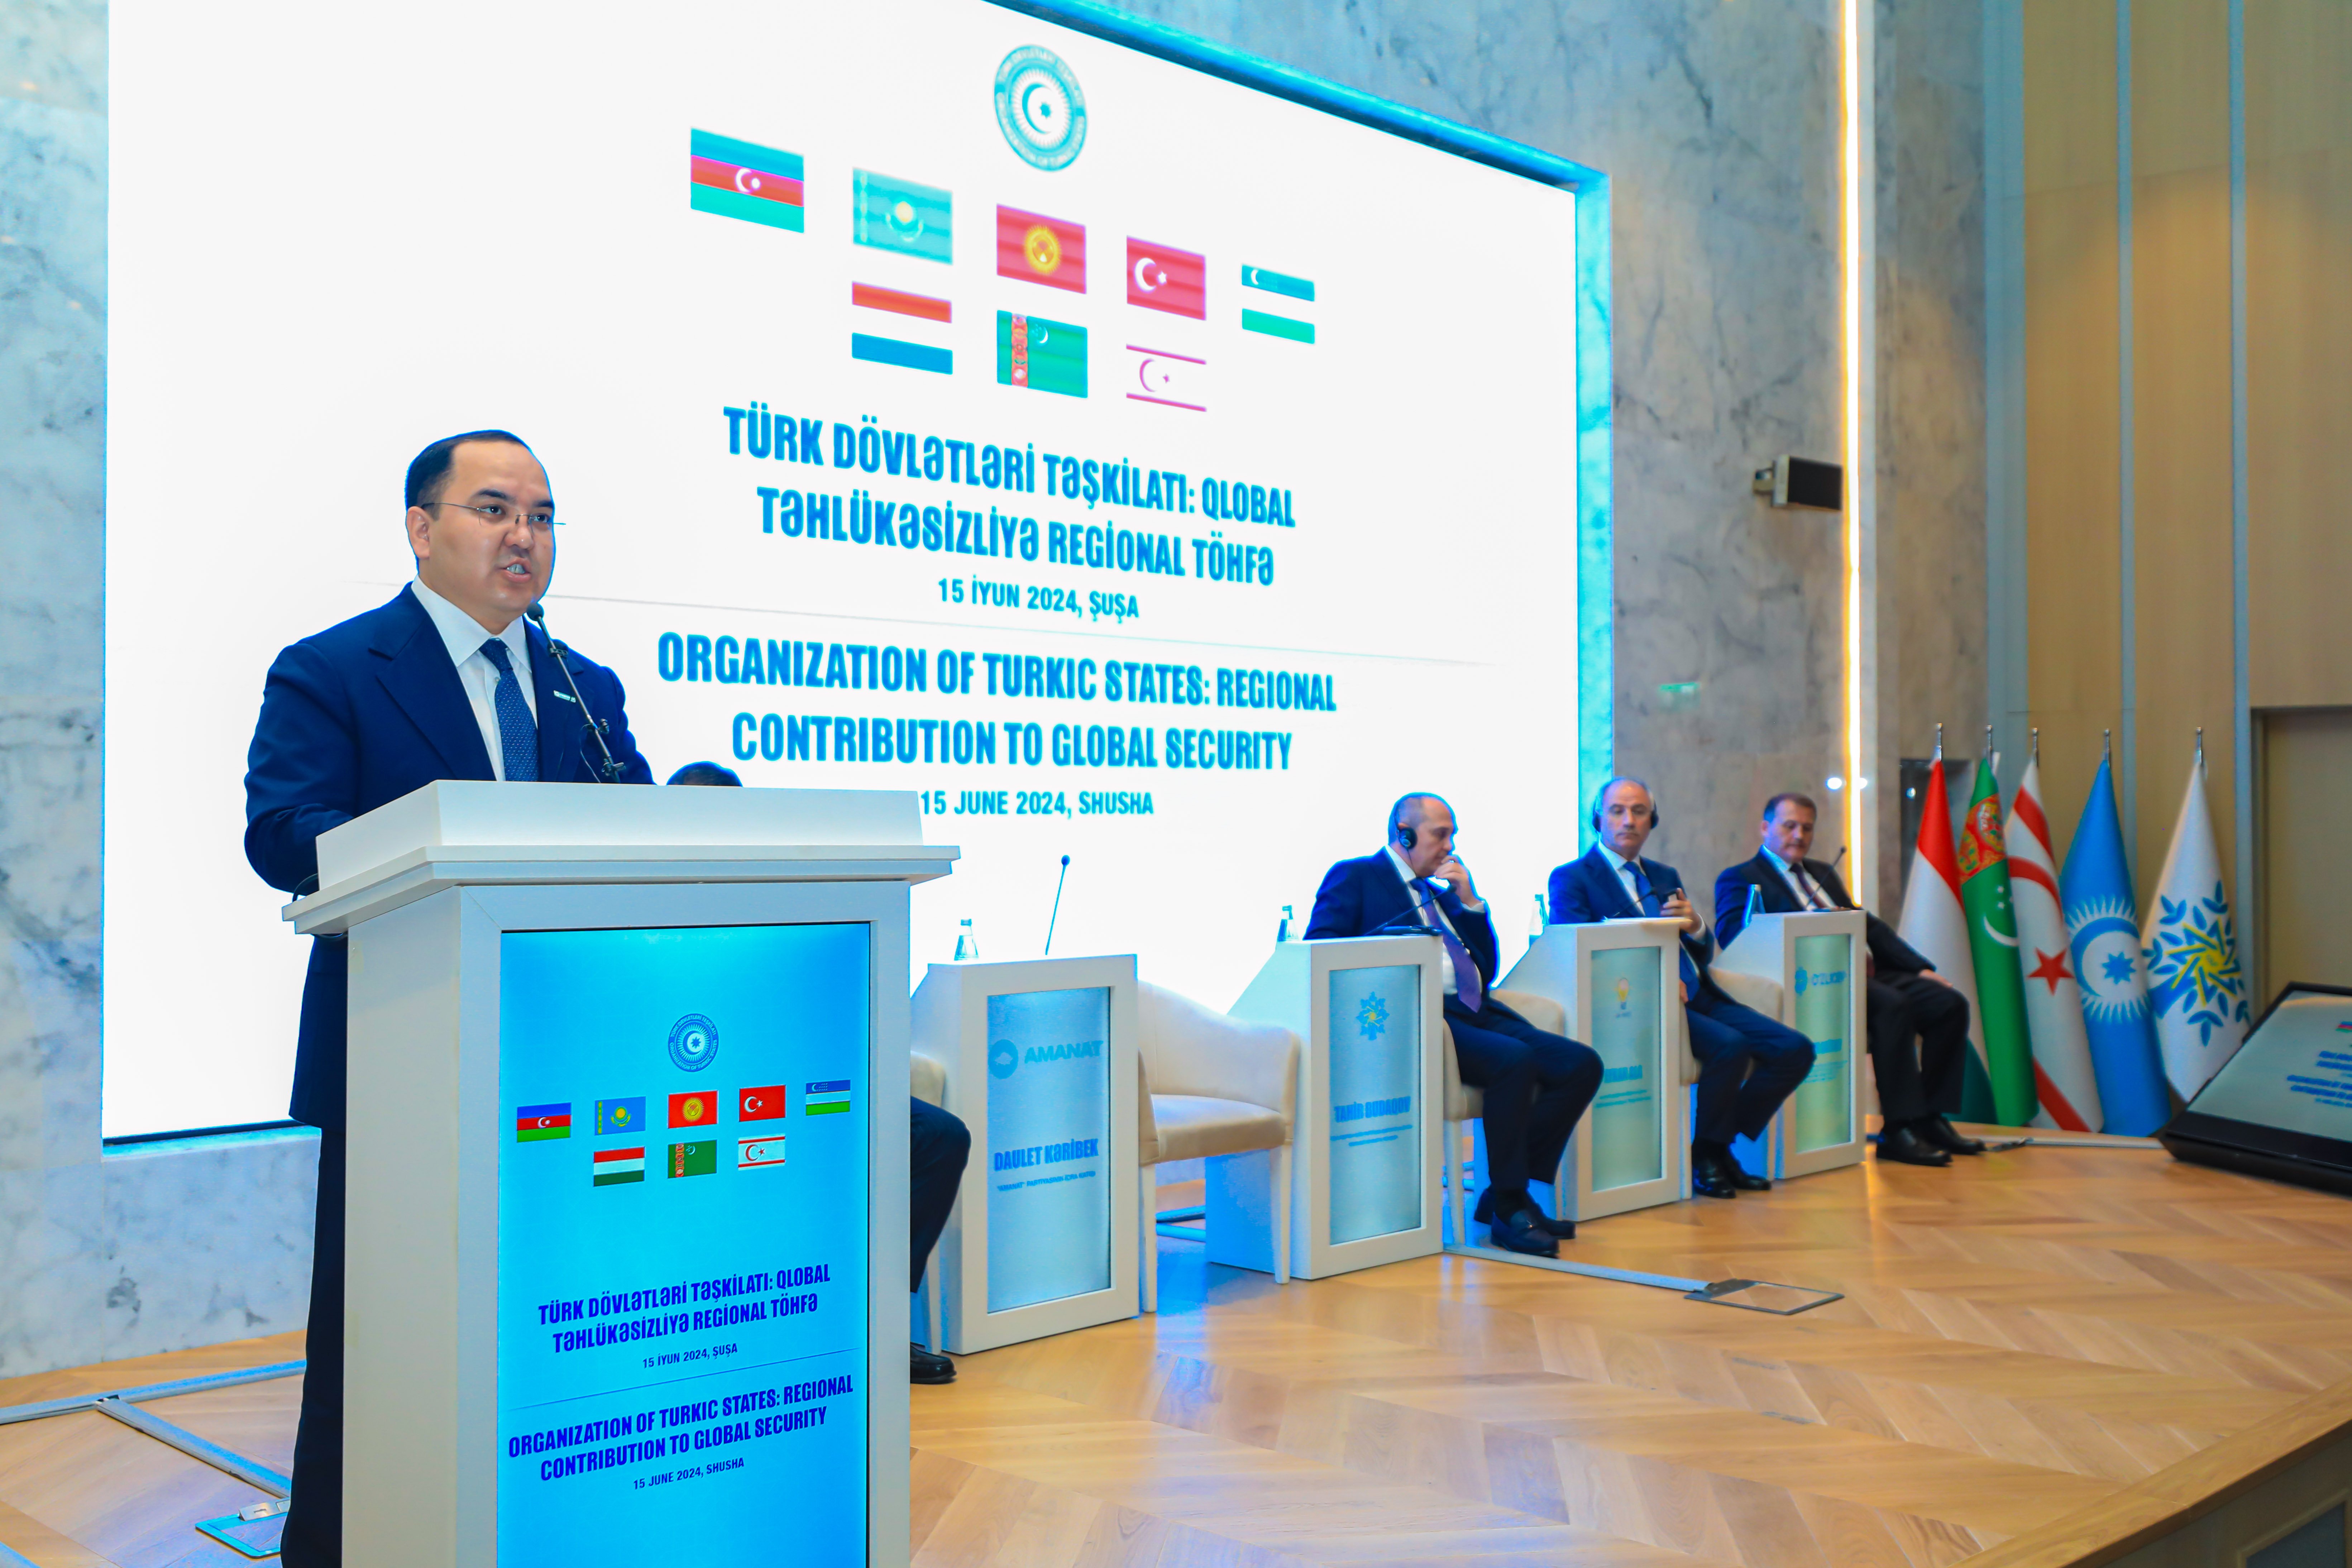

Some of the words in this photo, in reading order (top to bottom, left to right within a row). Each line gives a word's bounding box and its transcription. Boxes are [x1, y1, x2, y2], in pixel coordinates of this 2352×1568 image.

[723, 401, 824, 466] TÜRK
[833, 415, 1034, 494] DÖVLƏTLƏRİ
[1043, 454, 1195, 513] TƏŞKİLATI:
[1202, 477, 1296, 527] QLOBAL
[757, 485, 1039, 561] TƏHLÜKƏSİZLİYƏ
[1048, 520, 1185, 576] REGİONAL
[1192, 531, 1273, 586] TÖHFƏ
[938, 578, 964, 603] 15
[972, 574, 1019, 608] İYUN
[1027, 586, 1082, 618] 2024,
[1089, 591, 1139, 624] ŞUŞA
[658, 632, 927, 692] ORGANIZATION
[937, 649, 975, 694] OF
[983, 653, 1096, 701] TURKIC
[1105, 660, 1210, 706] STATES:
[1217, 668, 1337, 711] REGIONAL
[732, 712, 995, 765] CONTRIBUTION
[1004, 722, 1042, 766] TO
[1052, 723, 1158, 768] GLOBAL
[1166, 728, 1292, 770] SECURITY
[921, 790, 946, 814] 15
[954, 791, 1008, 814] JUNE
[1016, 791, 1071, 819] 2024,
[1079, 791, 1154, 814] SHUSHA
[1024, 1040, 1104, 1063] AMANAT
[994, 1147, 1043, 1171] DAULET
[1044, 1138, 1099, 1164] KƏRİBEK
[539, 1300, 584, 1325] TÜRK
[589, 1280, 688, 1315] DÖVLƏTLƏRİ
[691, 1273, 773, 1302] TƏŞKİLATI:
[777, 1264, 830, 1289] QLOBAL
[553, 1316, 689, 1353] TƏHLÜKƏSİZLİYƏ
[694, 1301, 767, 1330] REGİONAL
[771, 1293, 817, 1318] TÖHFƏ
[643, 1358, 654, 1368] 15
[658, 1352, 680, 1366] İYUN
[684, 1348, 710, 1362] 2024,
[713, 1343, 738, 1359] ŞUŞA
[509, 1416, 632, 1458] ORGANIZATION
[637, 1411, 655, 1433] OF
[659, 1400, 718, 1428] TURKIC
[723, 1389, 780, 1416] STATES:
[784, 1375, 853, 1405] REGIONAL
[541, 1437, 665, 1481] CONTRIBUTION
[670, 1433, 689, 1454] TO
[694, 1421, 751, 1449] GLOBAL
[755, 1406, 827, 1438] SECURITY
[634, 1478, 645, 1489] 15
[649, 1472, 673, 1486] JUNE
[677, 1467, 704, 1482] 2024,
[707, 1458, 744, 1474] SHUSHA
